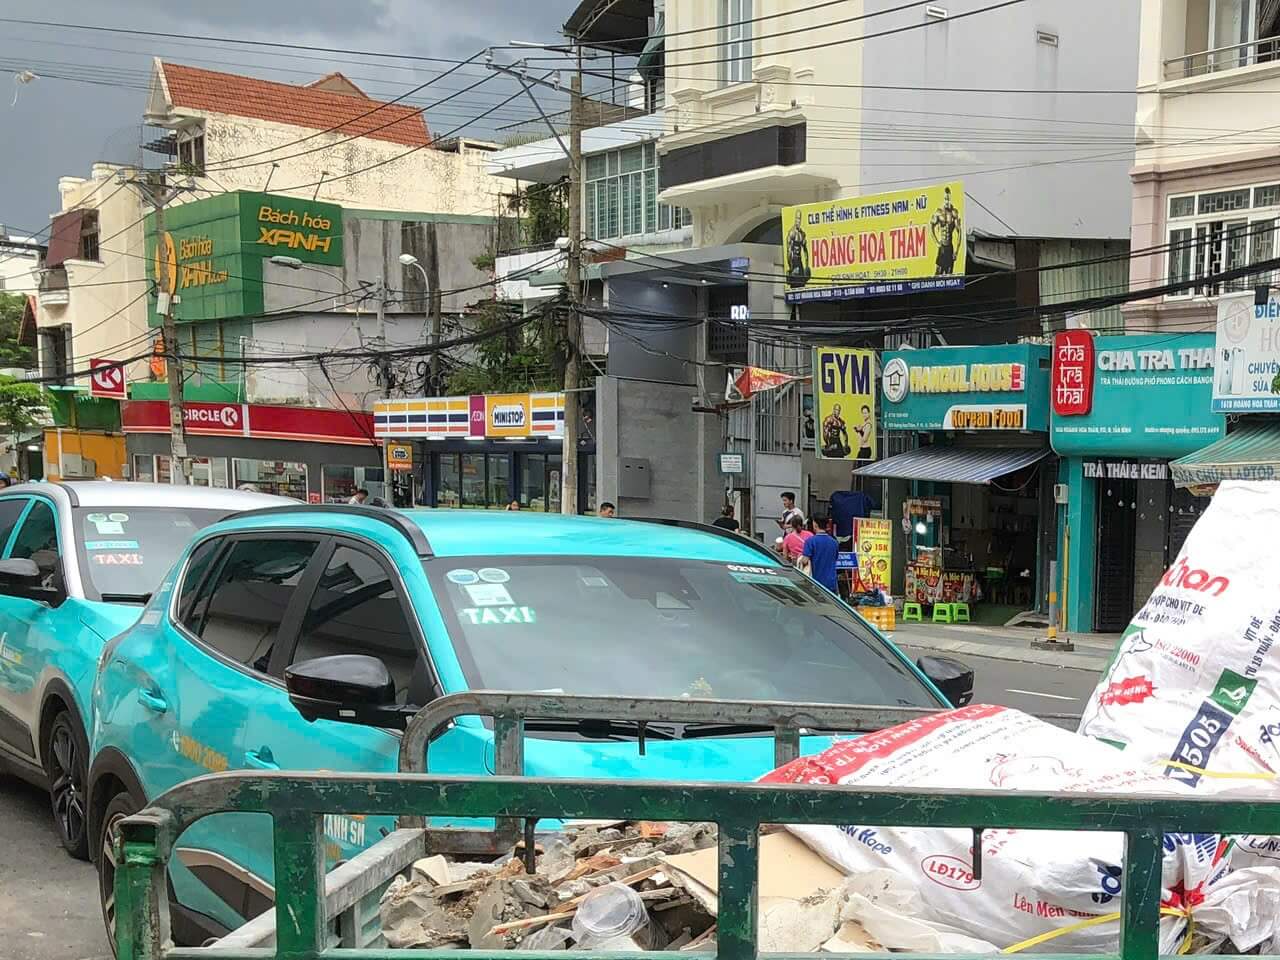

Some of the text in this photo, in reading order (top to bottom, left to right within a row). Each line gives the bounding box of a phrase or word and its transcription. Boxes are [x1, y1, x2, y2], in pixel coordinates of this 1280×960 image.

[258, 206, 332, 230] Bách hóa
[861, 203, 890, 218] FITNESS
[892, 200, 908, 213] NAM
[257, 228, 332, 253] XANH
[811, 231, 856, 268] HOÀNG
[859, 232, 888, 264] HOA
[1098, 348, 1216, 371] CHA TRA THA
[820, 353, 870, 396] GYM
[970, 363, 1025, 392] HOUSE
[494, 409, 524, 424] MINISTOP
[952, 408, 1023, 428] Korean Food
[1084, 460, 1104, 478] TRÀ
[1106, 460, 1130, 478] THÁI
[1140, 464, 1166, 480] KEM
[96, 554, 140, 564] TAXI
[464, 606, 534, 624] TAXI
[1169, 646, 1200, 666] 22000
[1254, 652, 1264, 668] 18
[1168, 714, 1222, 786] V505
[350, 820, 365, 848] SM
[836, 824, 892, 856] ew Hope
[928, 860, 974, 884] LĐ179
[1014, 892, 1034, 914] Lên
[1036, 902, 1065, 918] Men
